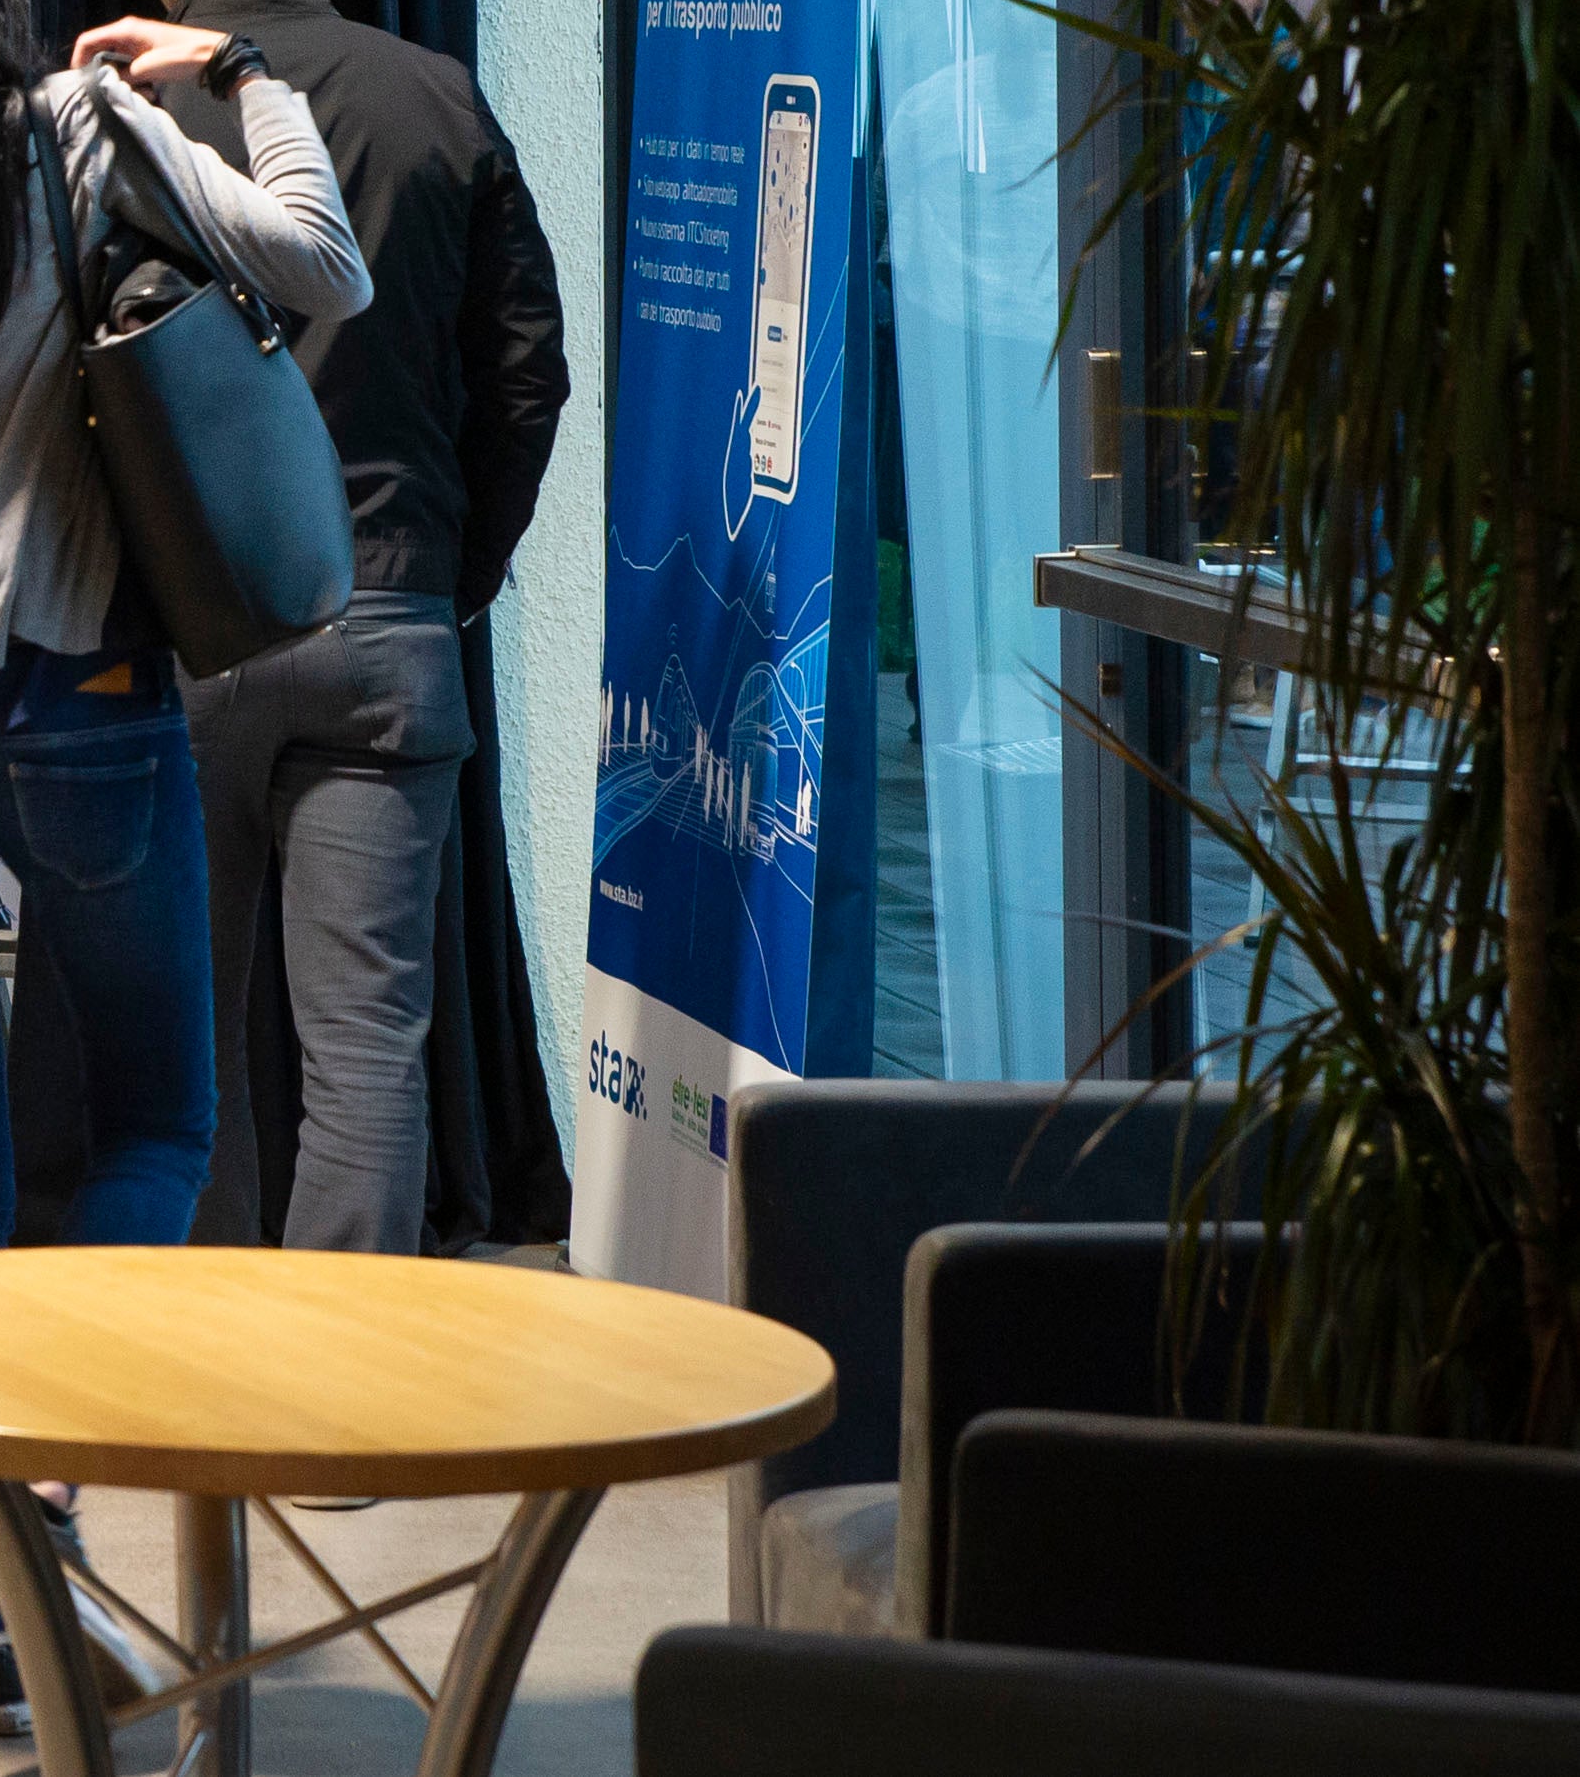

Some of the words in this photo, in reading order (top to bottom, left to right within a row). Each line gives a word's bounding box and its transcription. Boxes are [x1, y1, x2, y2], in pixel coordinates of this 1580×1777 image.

[645, 0, 663, 37] per
[660, 261, 693, 285] raccolta
[659, 303, 695, 330] trasporto
[599, 879, 643, 911] www.sta.bz.it
[589, 1029, 623, 1095] sta
